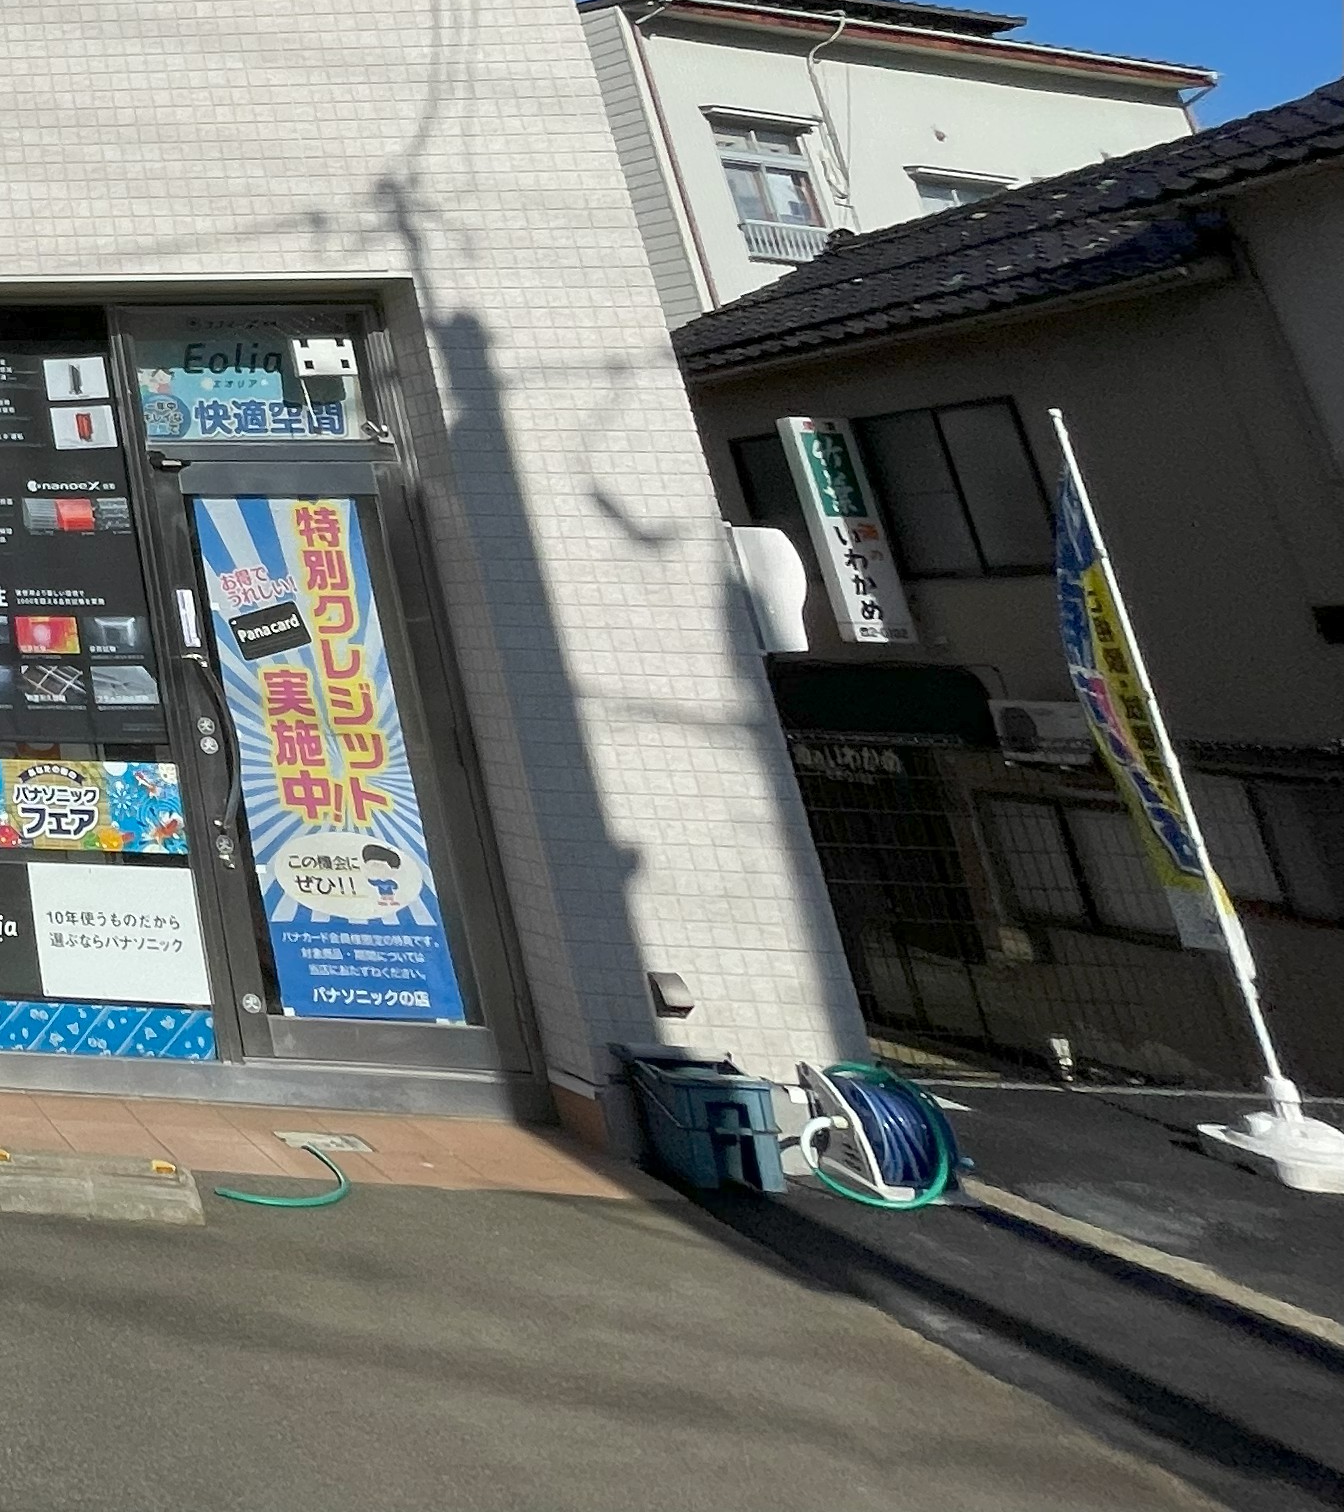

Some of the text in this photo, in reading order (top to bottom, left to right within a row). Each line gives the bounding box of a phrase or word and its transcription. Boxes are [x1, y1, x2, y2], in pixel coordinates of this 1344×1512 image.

[183, 342, 283, 374] Eolia
[195, 400, 345, 436] 快適空間
[237, 613, 300, 643] Panacard
[295, 505, 390, 824] 特別クレジット
[15, 786, 98, 804] パナソニック
[21, 806, 96, 835] フェア
[288, 854, 361, 871] この機会に
[46, 910, 181, 930] 10年使うものだから
[49, 932, 184, 953] 選ぶならパナソニック
[312, 986, 431, 1008] パナソニックの店
